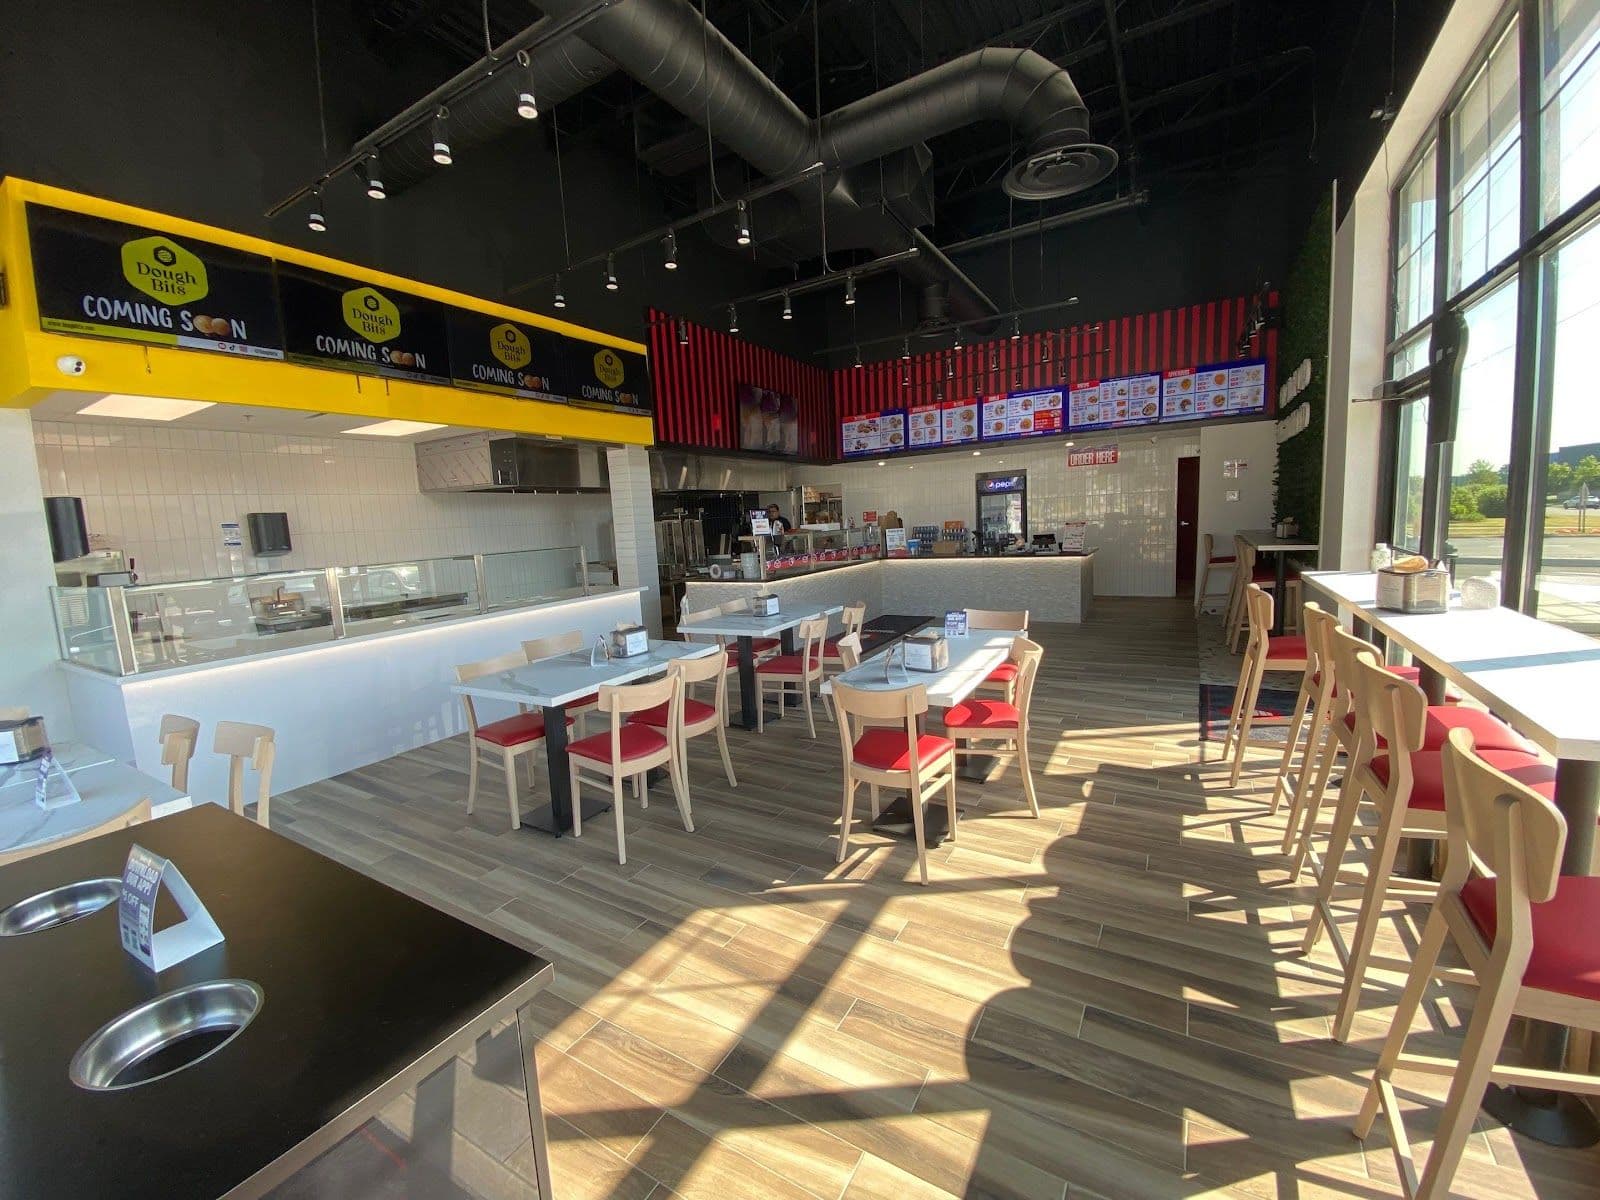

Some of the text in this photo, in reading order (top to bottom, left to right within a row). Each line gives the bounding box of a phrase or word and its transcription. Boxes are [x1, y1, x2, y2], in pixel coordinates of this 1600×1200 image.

[137, 262, 197, 287] Dough
[151, 278, 186, 296] Bits
[83, 295, 173, 329] COMING
[352, 307, 393, 327] Dough
[362, 321, 386, 336] Bits
[316, 335, 377, 360] COMING
[497, 341, 526, 355] Dough
[472, 364, 515, 385] COMING
[582, 384, 613, 402] COMING
[1071, 450, 1115, 466] ORDER HERE
